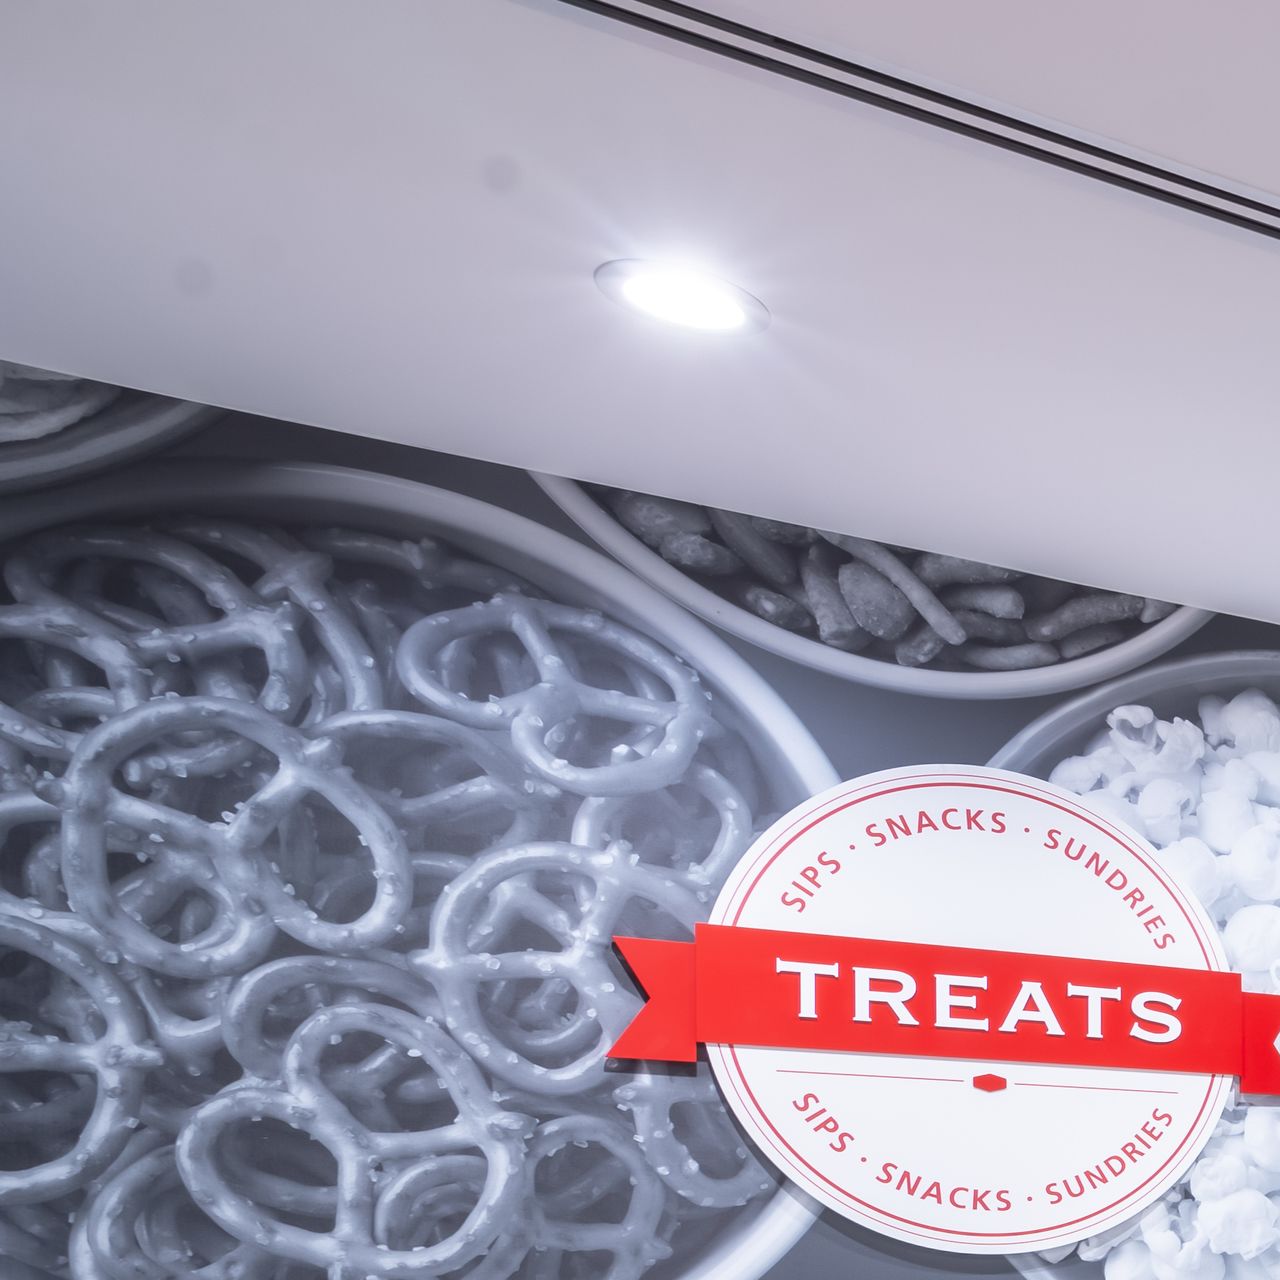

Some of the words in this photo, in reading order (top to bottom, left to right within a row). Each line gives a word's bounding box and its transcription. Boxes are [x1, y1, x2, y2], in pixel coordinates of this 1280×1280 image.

[781, 851, 842, 913] SIPS
[864, 808, 1007, 847] SNACKS
[1043, 828, 1176, 951] SUNDRIES
[775, 956, 1183, 1044] TREATS
[793, 1092, 855, 1154] SIPS
[875, 1160, 1013, 1212] SNACKS
[1046, 1107, 1173, 1205] SUNDRIES
